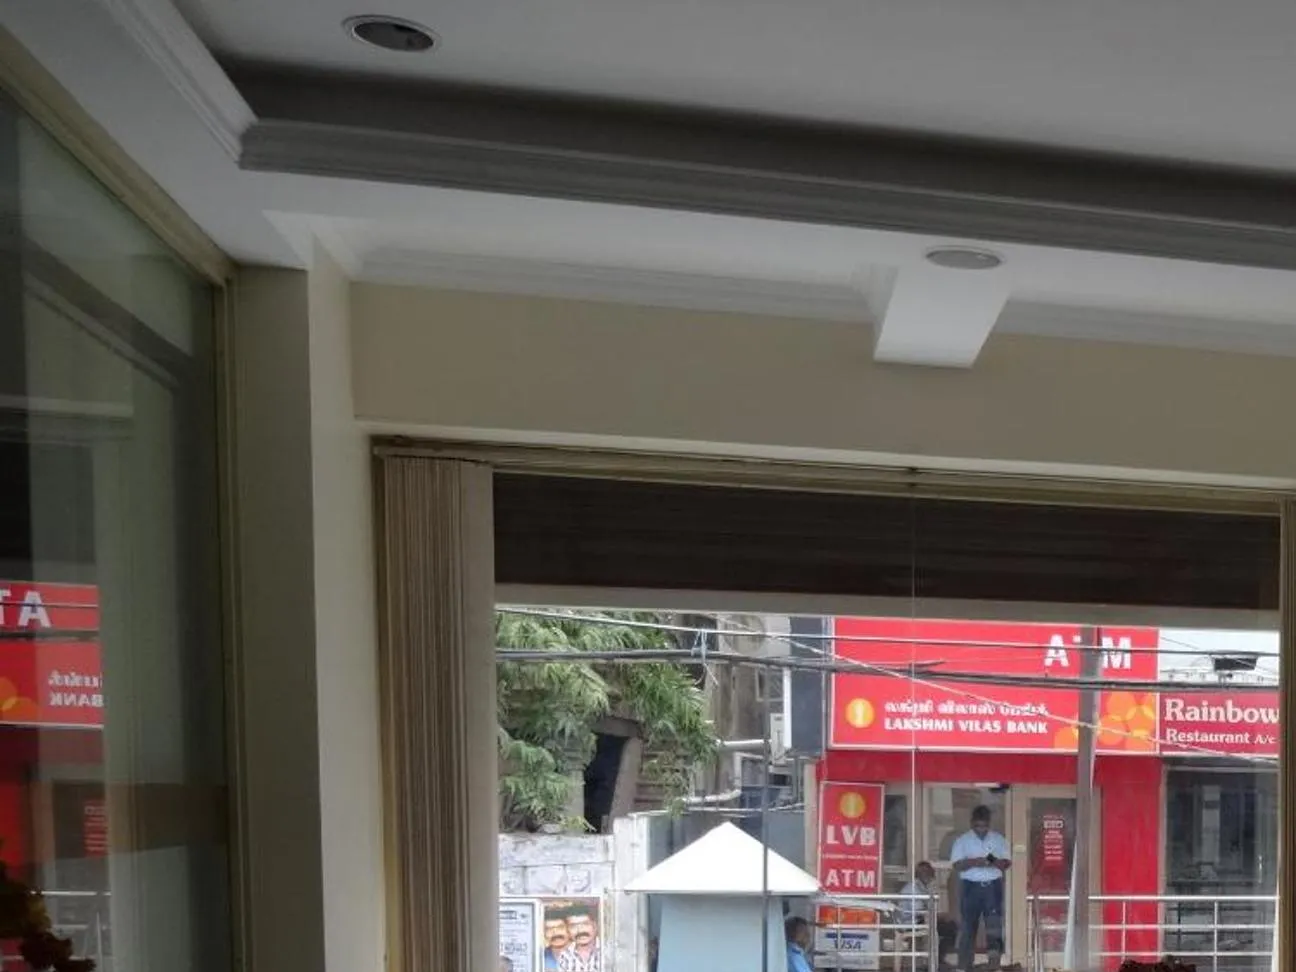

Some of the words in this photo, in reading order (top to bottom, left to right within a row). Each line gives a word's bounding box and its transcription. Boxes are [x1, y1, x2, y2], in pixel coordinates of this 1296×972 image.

[1044, 633, 1132, 669] AM
[1164, 698, 1280, 724] Rainbow
[884, 718, 953, 732] LAKSHMI
[958, 719, 1001, 733] VILAS
[1006, 720, 1048, 734] BANK
[1166, 729, 1250, 745] Restaurant
[826, 824, 876, 846] LVB
[825, 868, 875, 888] ATM
